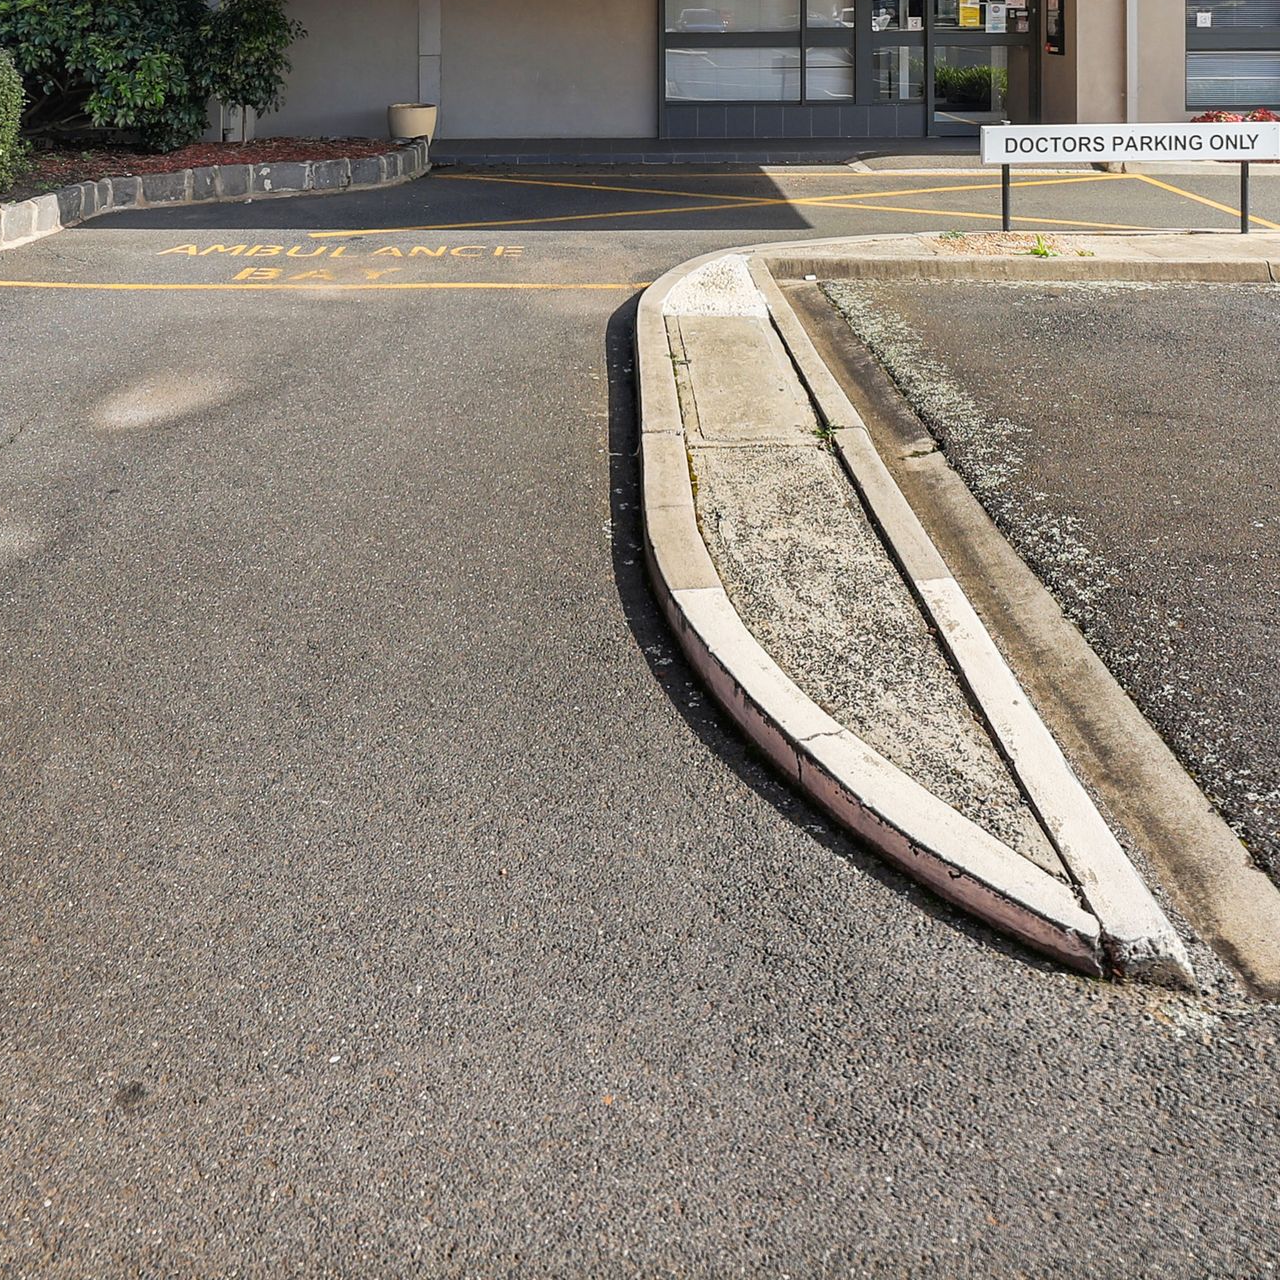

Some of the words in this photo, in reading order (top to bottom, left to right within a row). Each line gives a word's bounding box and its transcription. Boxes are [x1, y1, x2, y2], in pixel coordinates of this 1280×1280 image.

[1004, 136, 1105, 154] DOCTORS
[1112, 135, 1203, 152] PARKING
[1209, 133, 1259, 151] ONLY
[156, 243, 525, 259] AMBULANCE
[231, 267, 407, 281] BAY
